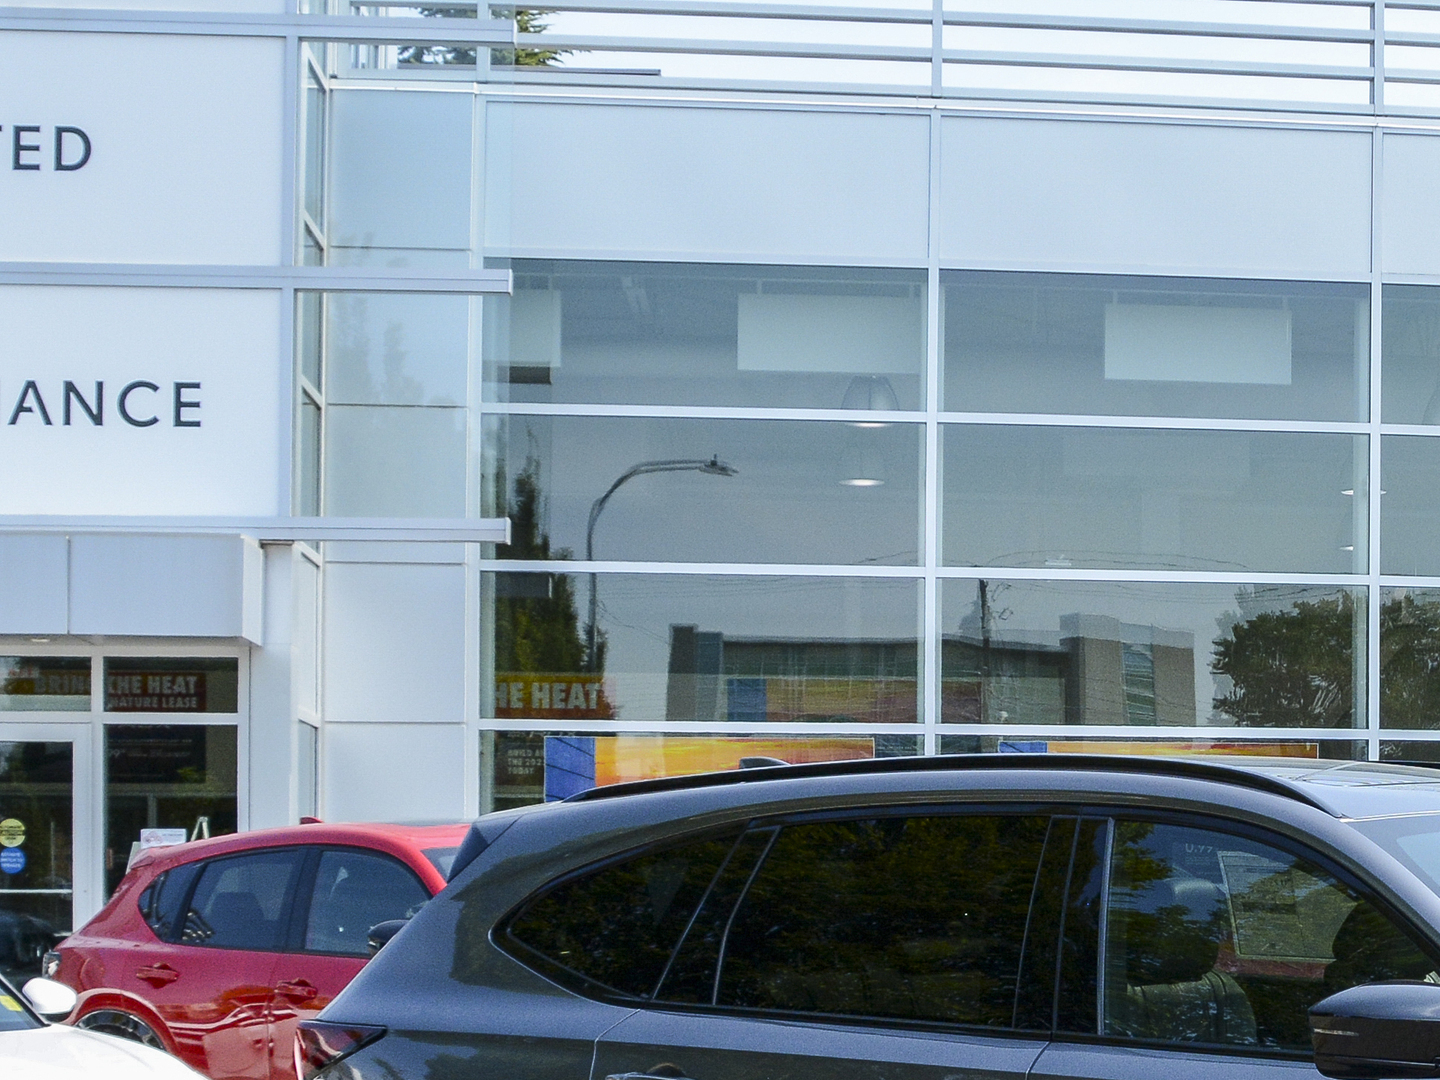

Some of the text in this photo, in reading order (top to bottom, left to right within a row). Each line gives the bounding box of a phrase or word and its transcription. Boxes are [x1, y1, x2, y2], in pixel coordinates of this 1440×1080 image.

[0, 125, 92, 172] ED
[147, 675, 198, 694] HEAT
[495, 682, 601, 710] HE HEAT
[162, 696, 197, 708] LEASE
